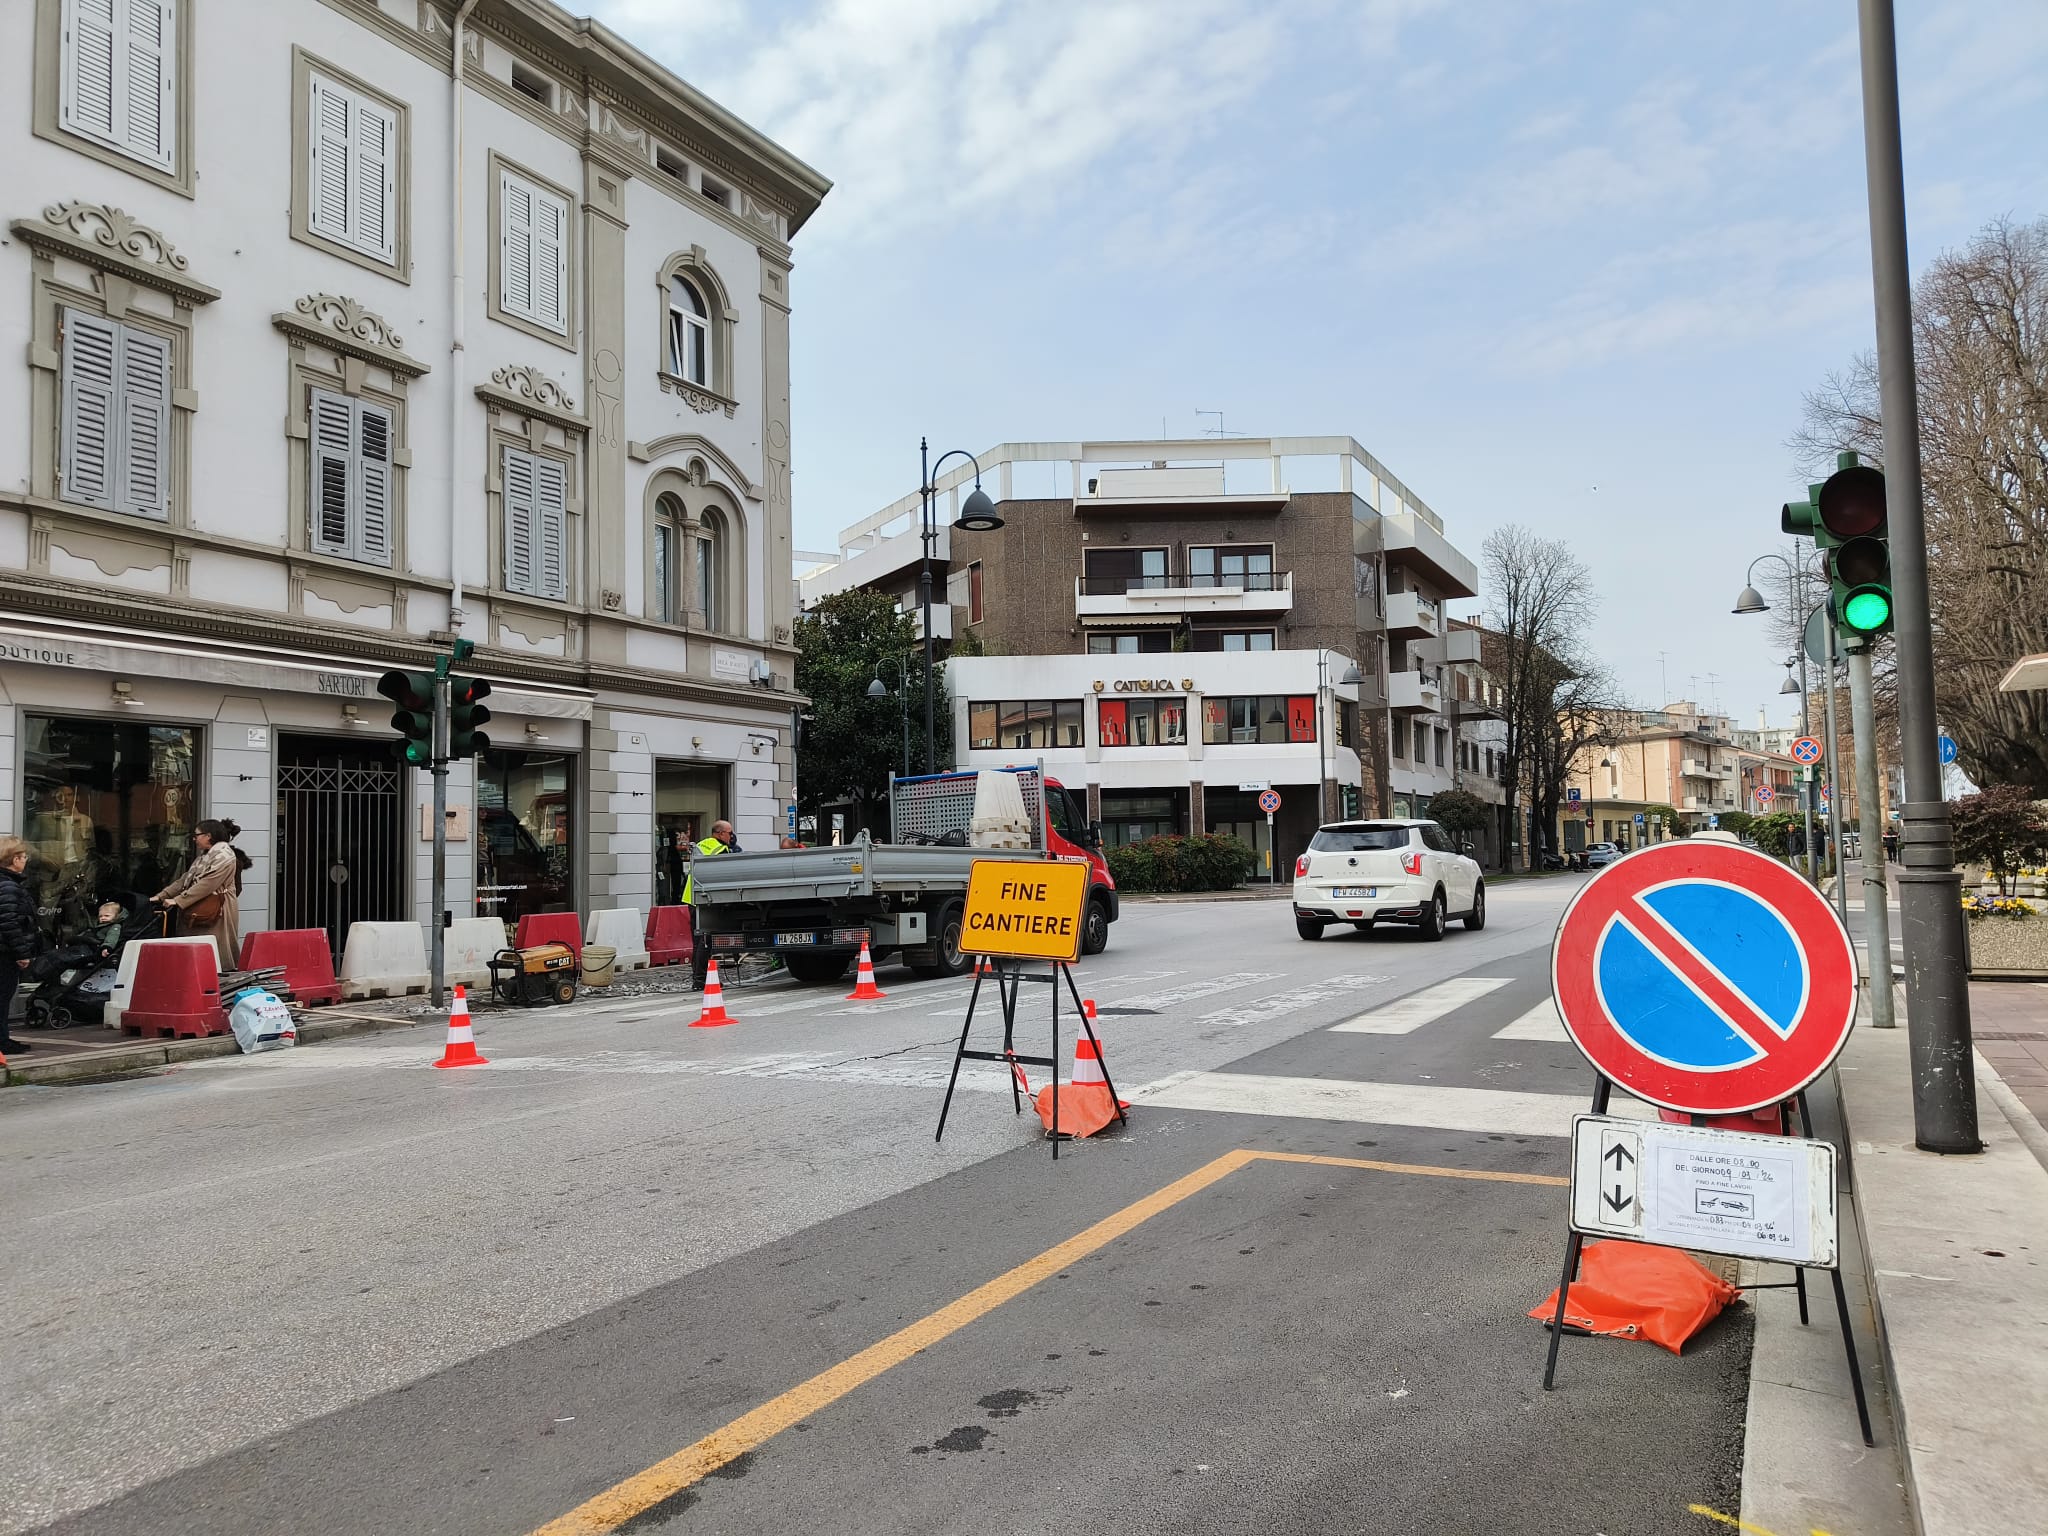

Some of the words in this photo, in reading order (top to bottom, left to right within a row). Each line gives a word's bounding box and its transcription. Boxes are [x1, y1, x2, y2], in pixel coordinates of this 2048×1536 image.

[318, 673, 366, 697] SARTORI
[1113, 680, 1175, 692] CATTOLICA
[1001, 882, 1047, 901] FINE
[969, 912, 1072, 936] CANTIERE
[559, 957, 570, 967] CAT
[1690, 1155, 1712, 1163] DALLE
[1716, 1157, 1730, 1165] ORE
[1676, 1164, 1689, 1172] DEL
